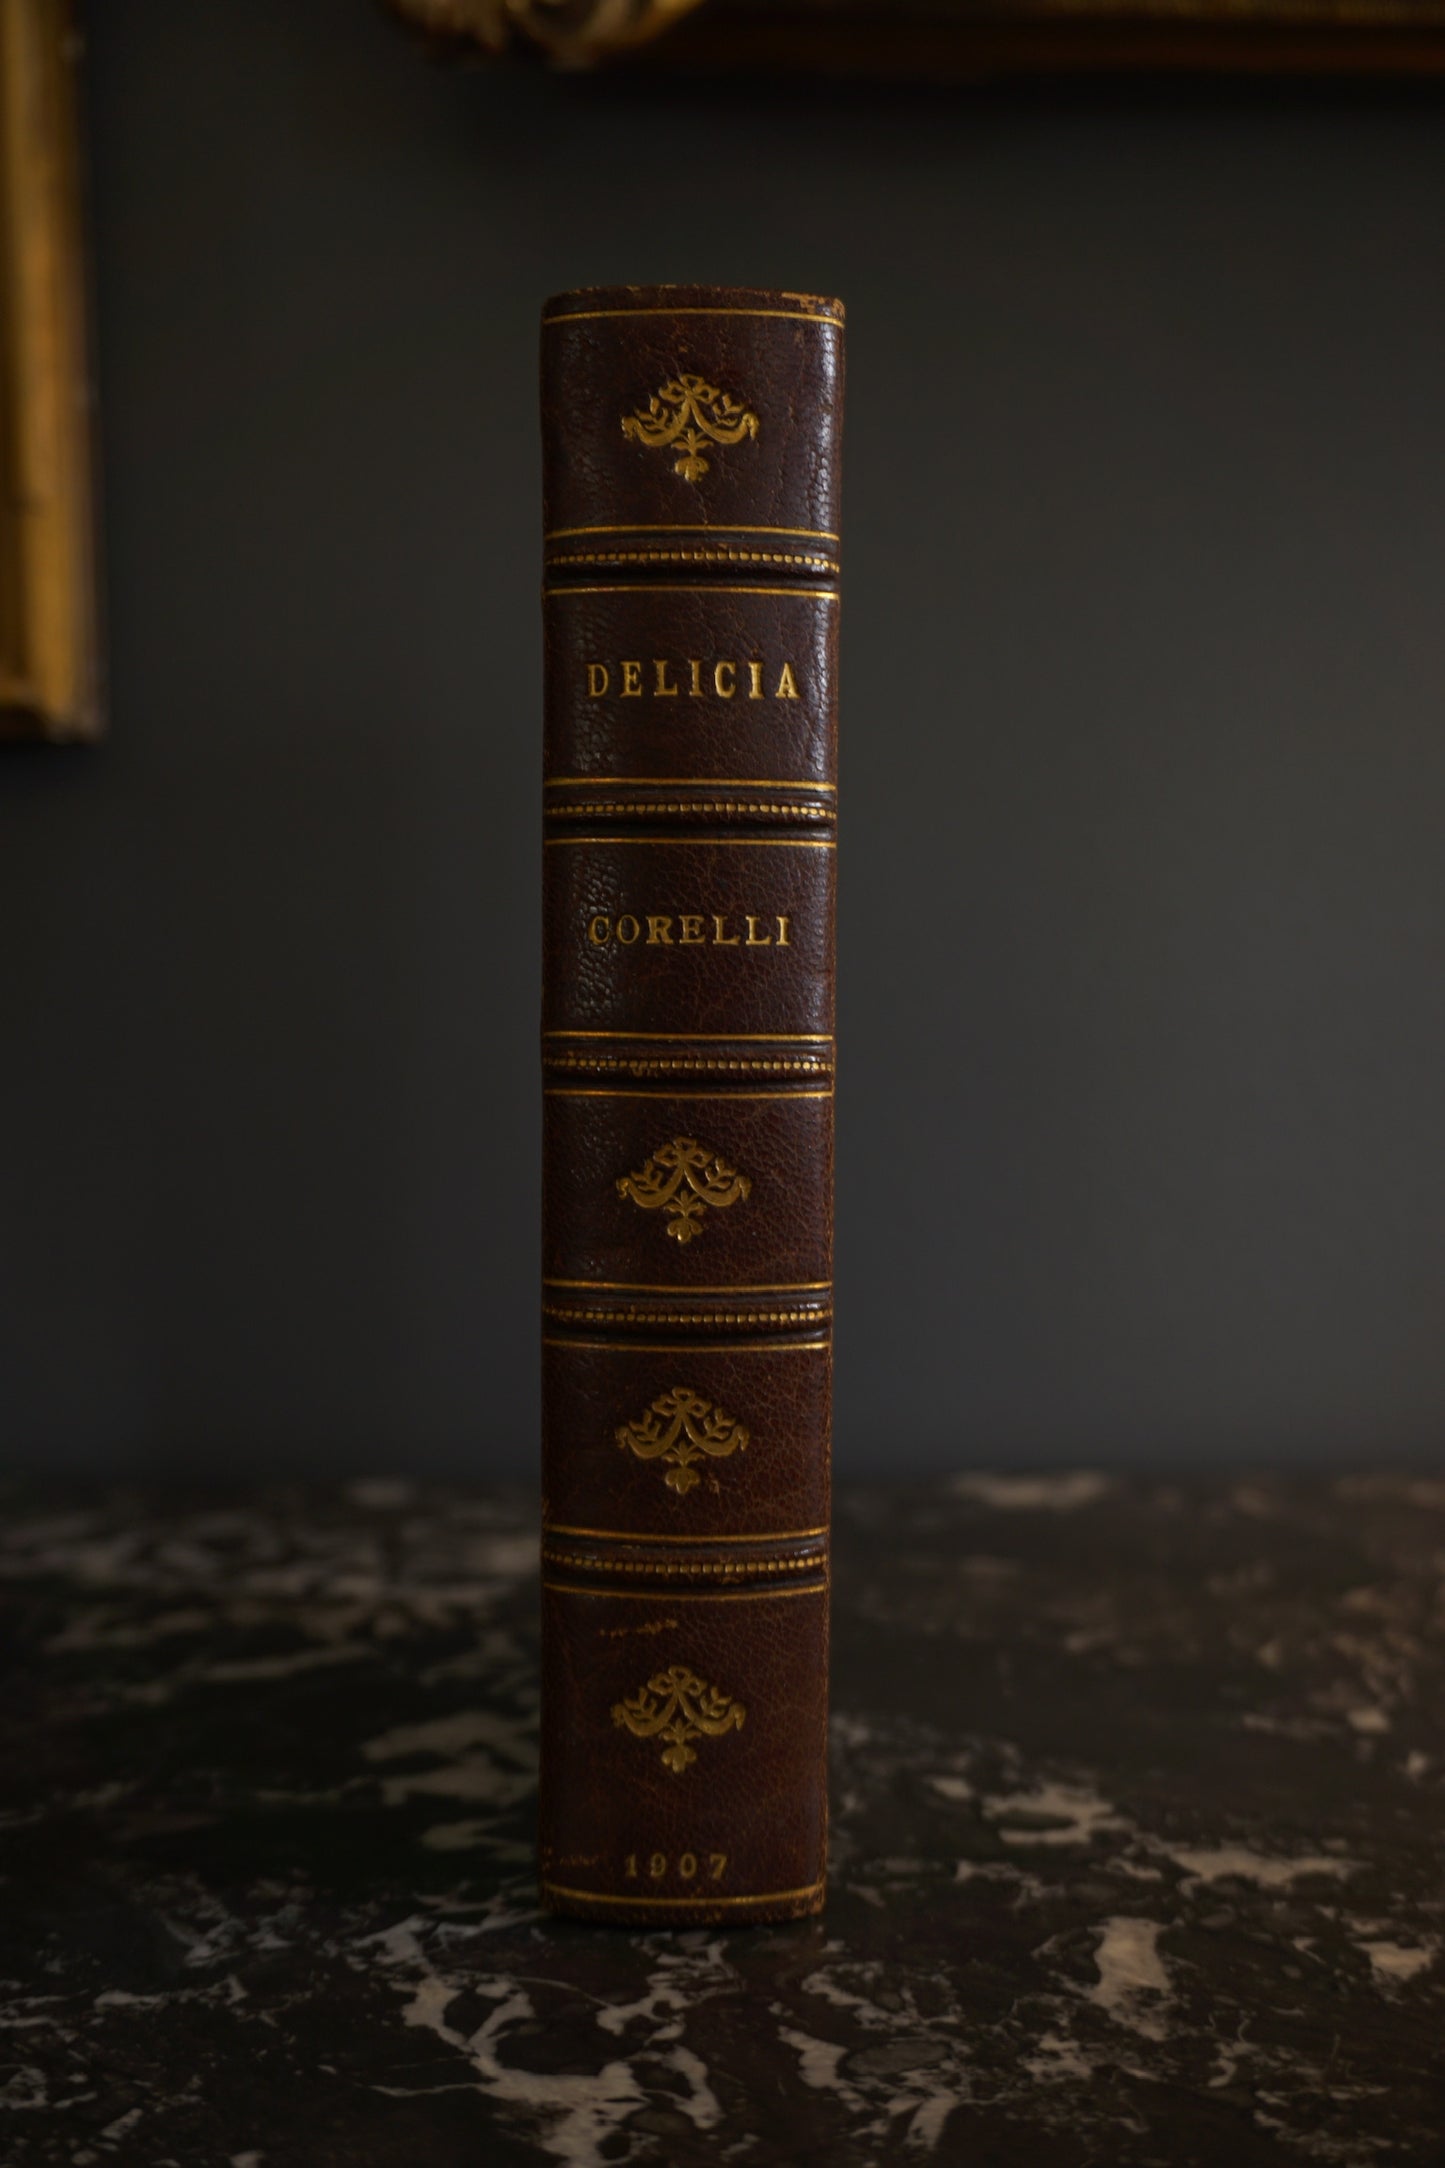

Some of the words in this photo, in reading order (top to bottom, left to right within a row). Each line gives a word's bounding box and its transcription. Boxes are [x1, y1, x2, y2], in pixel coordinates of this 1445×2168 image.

[586, 659, 800, 699] DELICIA
[588, 914, 792, 946] CORELLI
[624, 1853, 728, 1880] 1907
